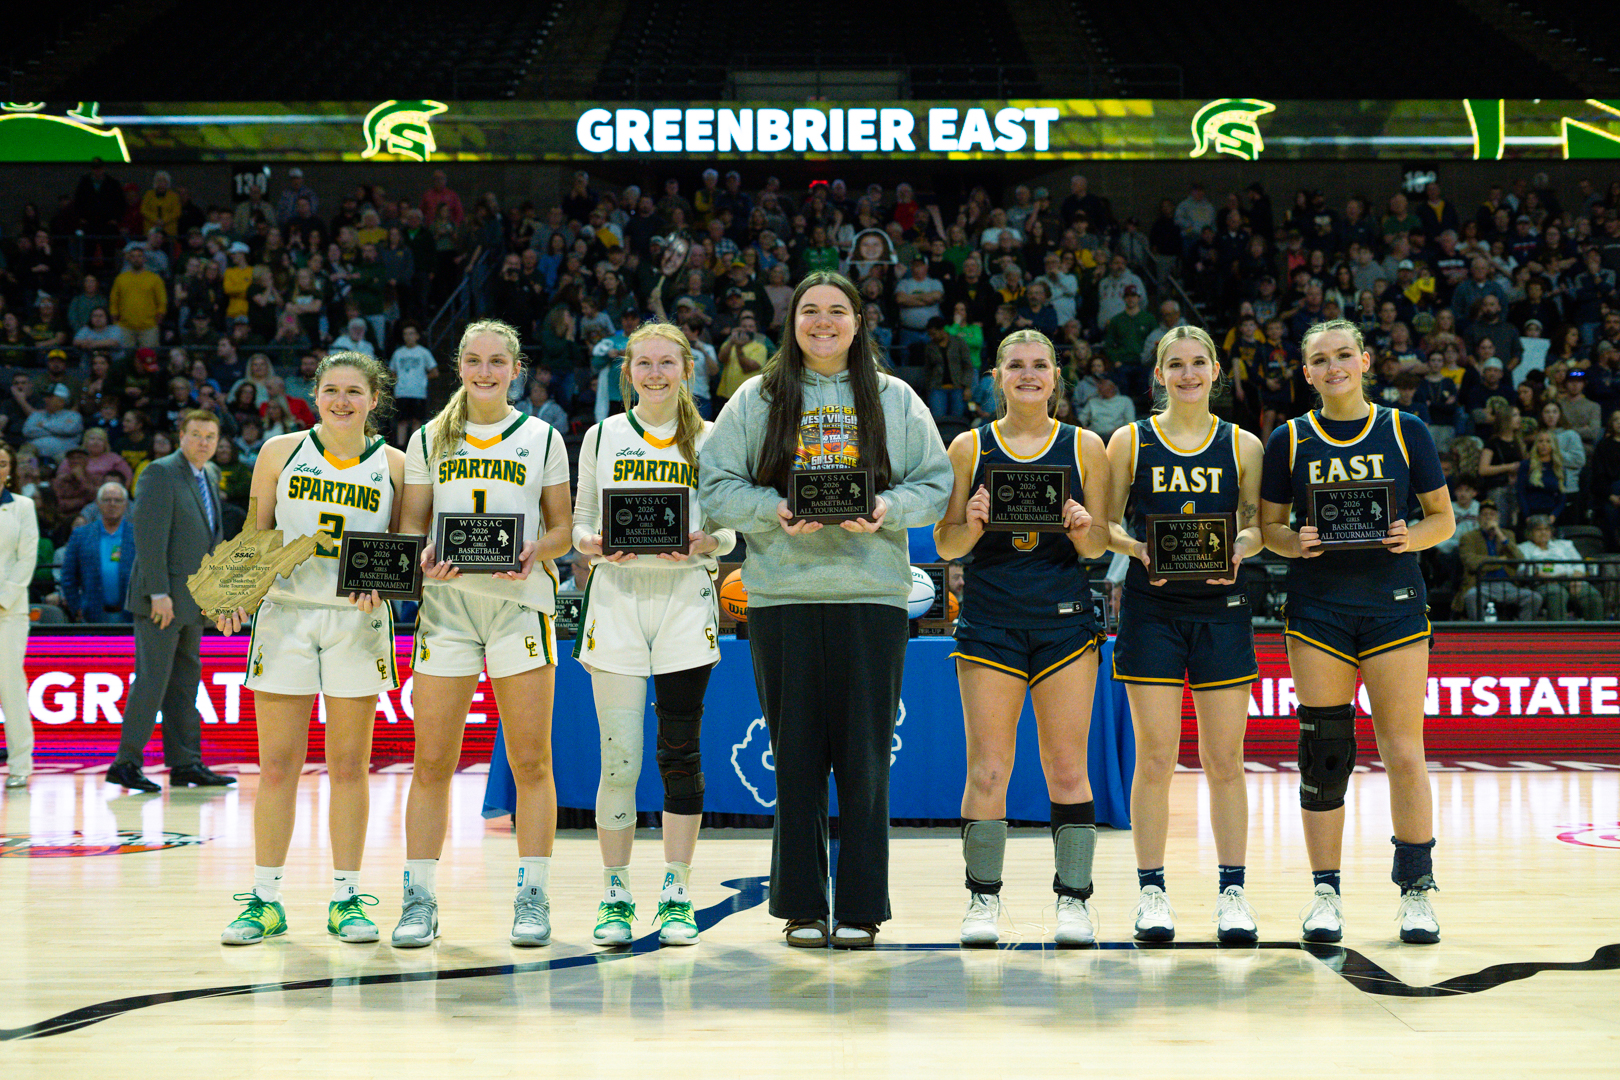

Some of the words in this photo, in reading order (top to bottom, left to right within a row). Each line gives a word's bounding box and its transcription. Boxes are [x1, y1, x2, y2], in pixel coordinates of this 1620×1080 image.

[576, 108, 916, 152] GREENBRIER
[928, 107, 1059, 152] EAST
[816, 405, 853, 414] 2026
[616, 447, 646, 457] Lady
[294, 463, 323, 476] Lady
[439, 458, 526, 486] SPARTANS
[613, 459, 698, 490] SPARTANS
[1308, 454, 1384, 484] EAST
[1151, 466, 1222, 494] EAST
[288, 475, 381, 513] SPARTANS
[1330, 491, 1373, 500] WVSSAC
[1170, 522, 1211, 530] WVSSAC
[1332, 523, 1375, 531] BASKETBALL
[314, 512, 346, 559] 2
[1335, 530, 1386, 539] TOURNAMENT
[362, 541, 404, 550] WVSSAC
[360, 572, 400, 580] BASKETBALL
[362, 580, 410, 590] TOURNAMENT
[728, 602, 748, 616] Wil
[28, 671, 246, 724] GRT
